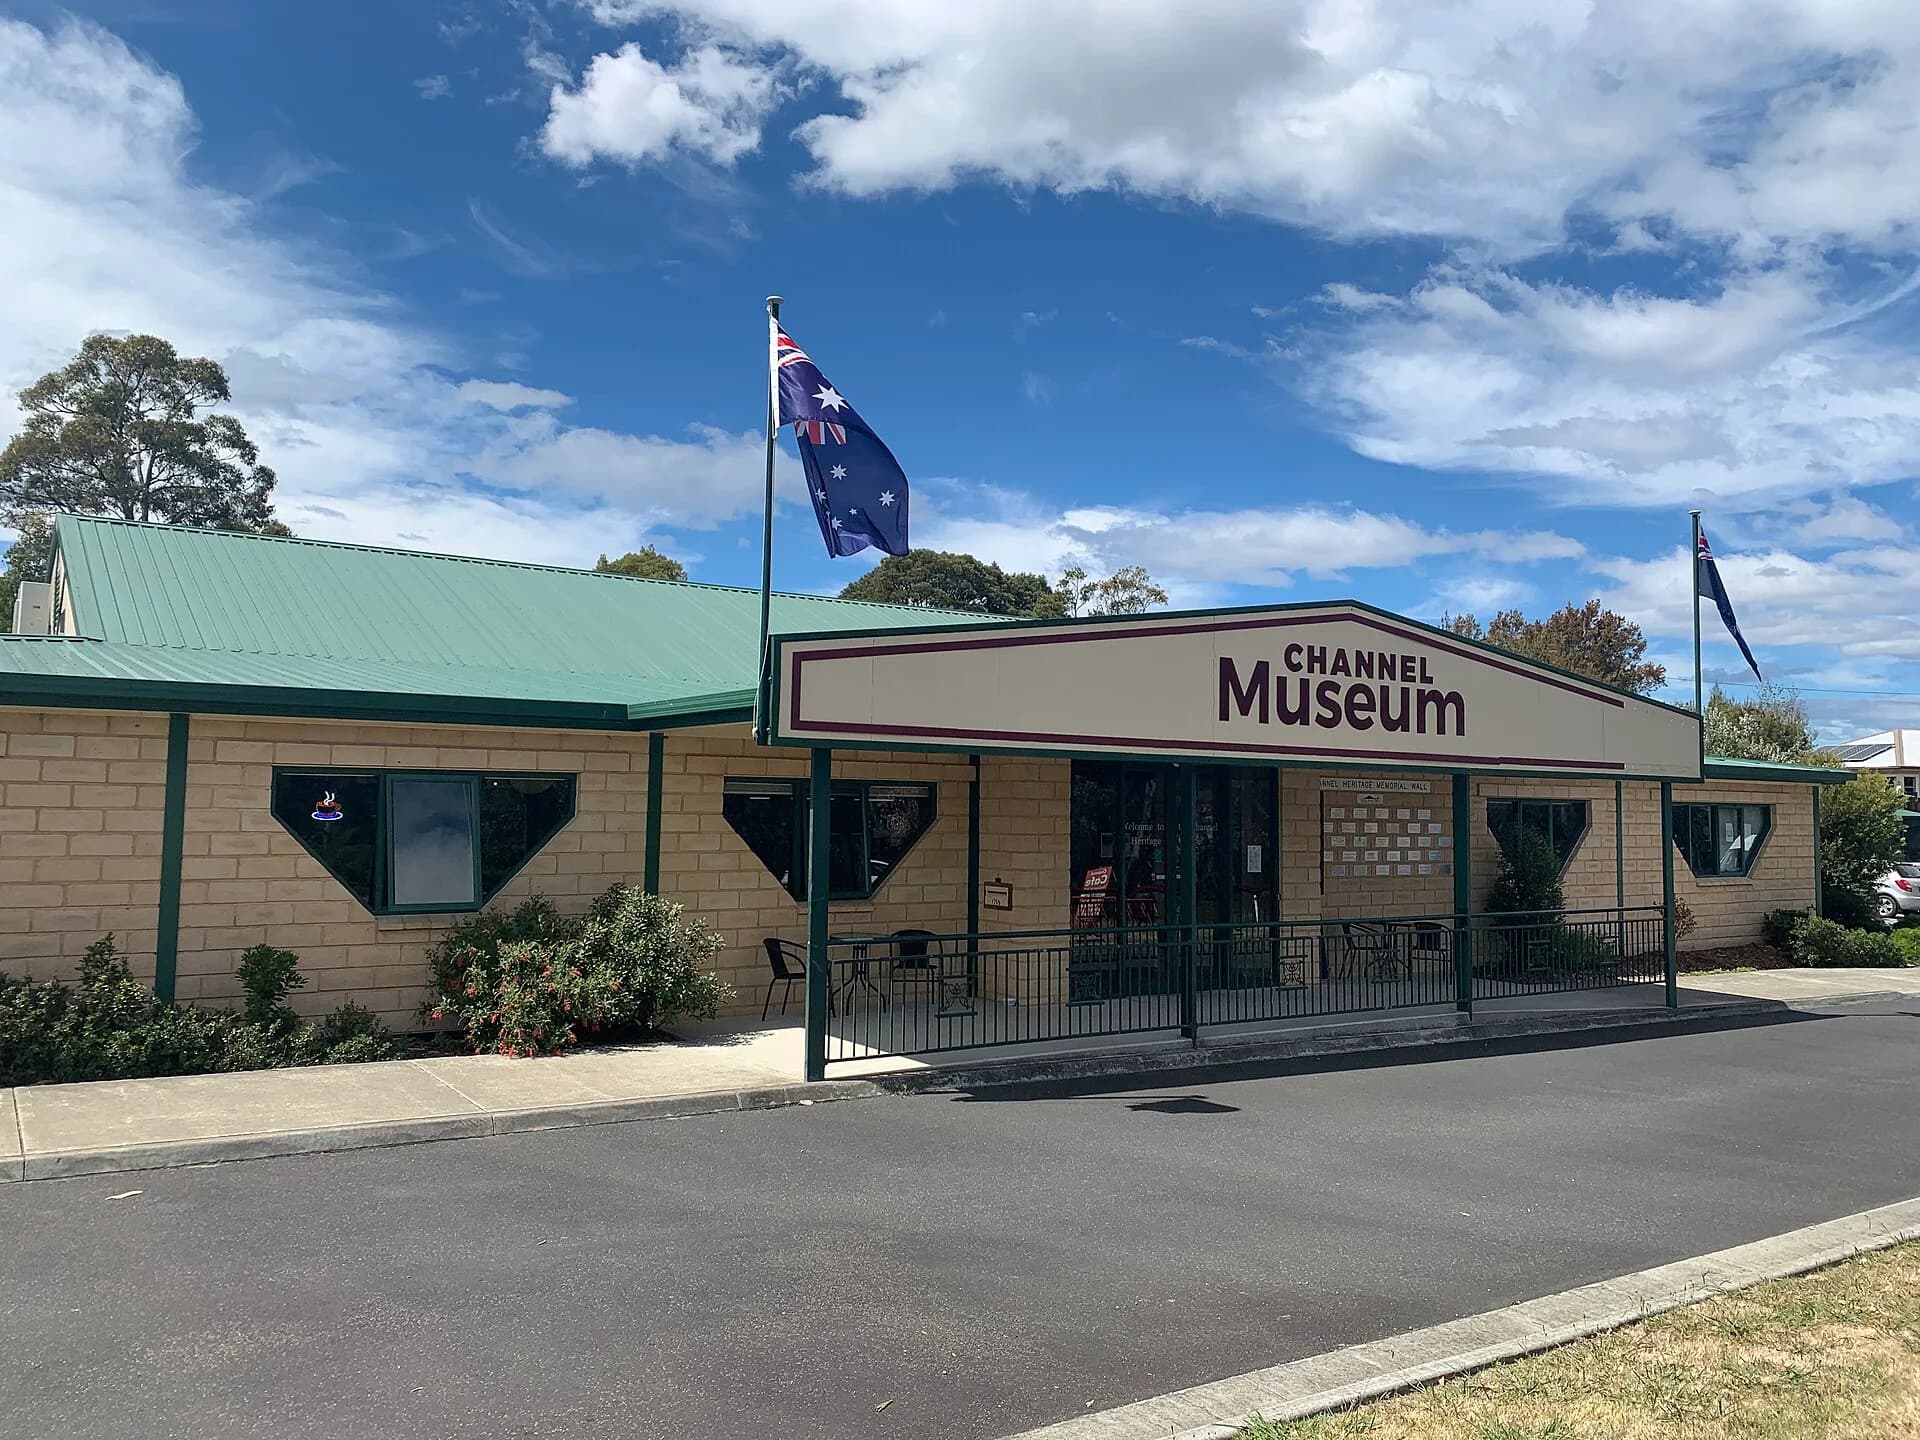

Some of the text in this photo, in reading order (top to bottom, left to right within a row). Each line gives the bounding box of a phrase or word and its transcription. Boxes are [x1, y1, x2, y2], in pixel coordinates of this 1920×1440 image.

[1284, 643, 1434, 684] CHANNEL
[1219, 657, 1466, 736] Museum
[1342, 780, 1373, 789] HERITAGE
[1376, 781, 1408, 790] MEMORIAL
[1411, 783, 1429, 791] WALL
[1157, 823, 1165, 831] to
